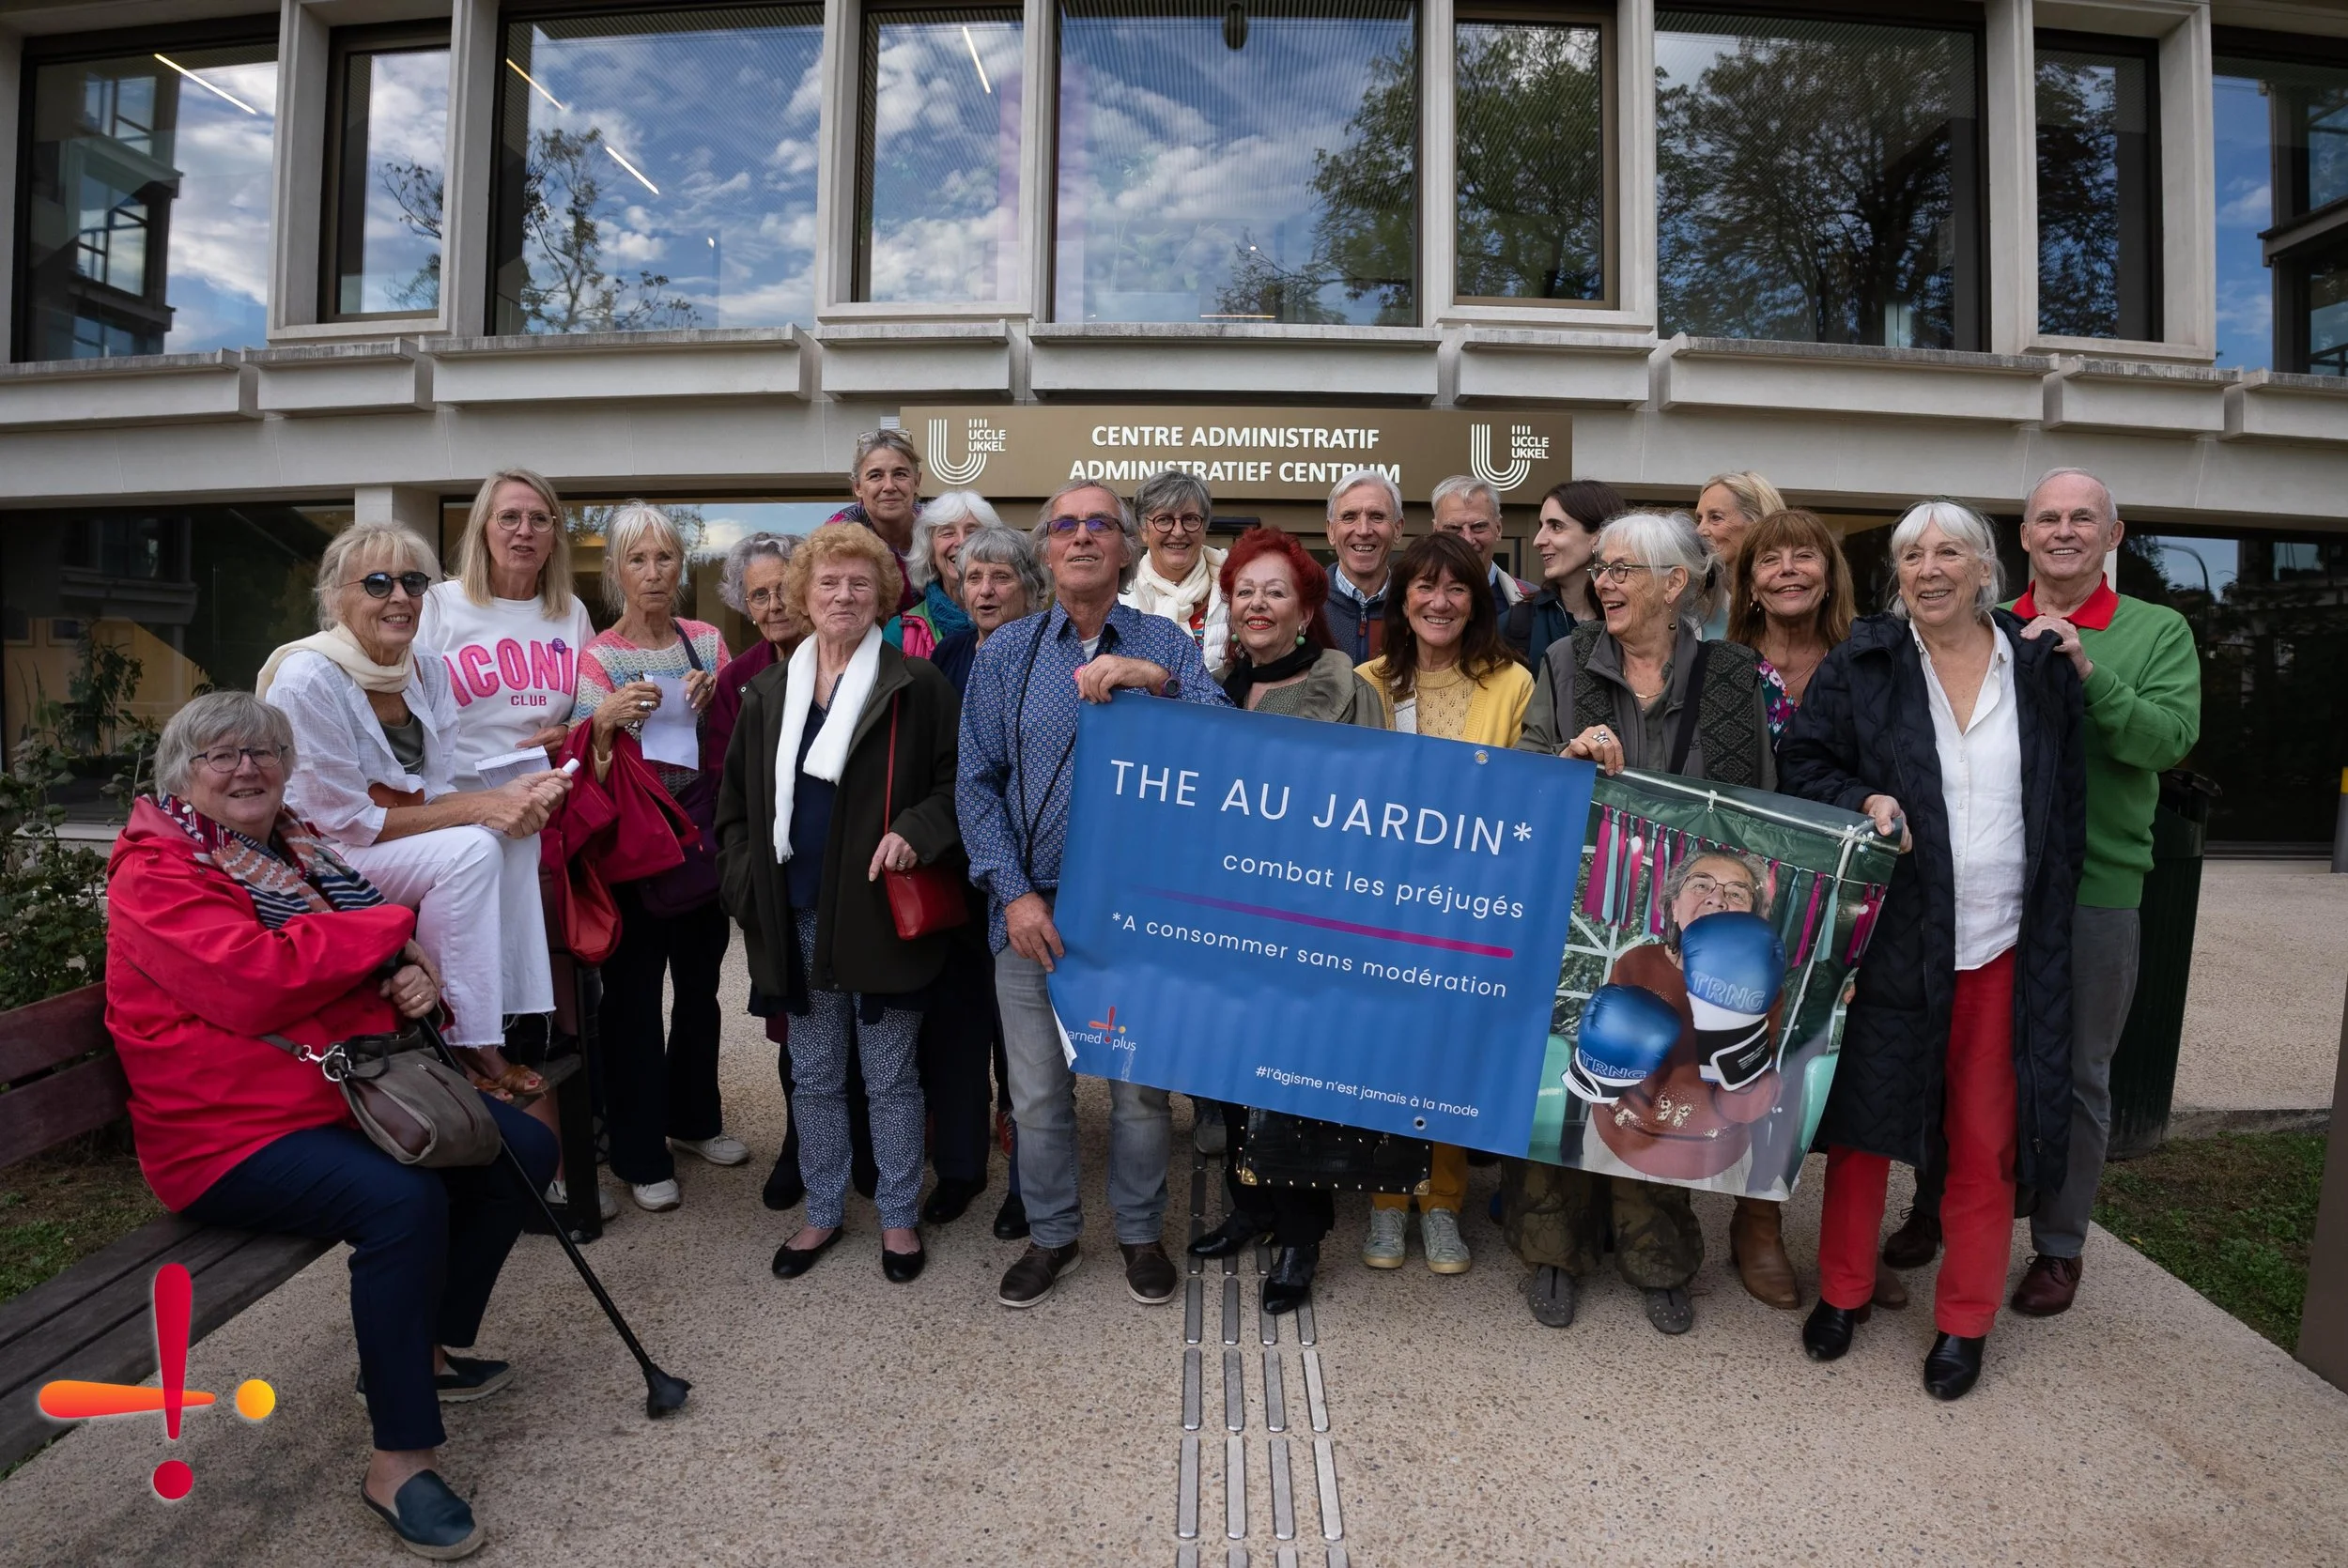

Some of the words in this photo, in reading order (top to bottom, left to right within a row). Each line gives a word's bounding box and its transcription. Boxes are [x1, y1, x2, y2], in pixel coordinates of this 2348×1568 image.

[968, 429, 1006, 439] UCCLE
[1091, 425, 1183, 447] CENTRE
[1190, 426, 1380, 449] ADMINISTRATIF
[1511, 436, 1549, 447] UCCLE
[968, 441, 1006, 452] UKKEL
[1511, 448, 1549, 459] UKKEL
[510, 695, 548, 706] CLUB
[1110, 760, 1199, 807] THE
[1220, 778, 1290, 820] AU
[1223, 853, 1335, 888] combat
[1345, 870, 1384, 897] les
[1396, 881, 1523, 919] préjugés
[1146, 920, 1289, 959] consommer
[1297, 949, 1353, 971] sans
[1363, 960, 1506, 997] modération
[1691, 970, 1766, 1011] TRNG
[1112, 1036, 1136, 1052] plus
[1581, 1050, 1646, 1079] TRNG
[1325, 1080, 1358, 1096] n'est
[1359, 1085, 1407, 1105] jamais
[1410, 1096, 1419, 1107] à
[1422, 1098, 1435, 1110] la
[1438, 1102, 1479, 1117] mode
